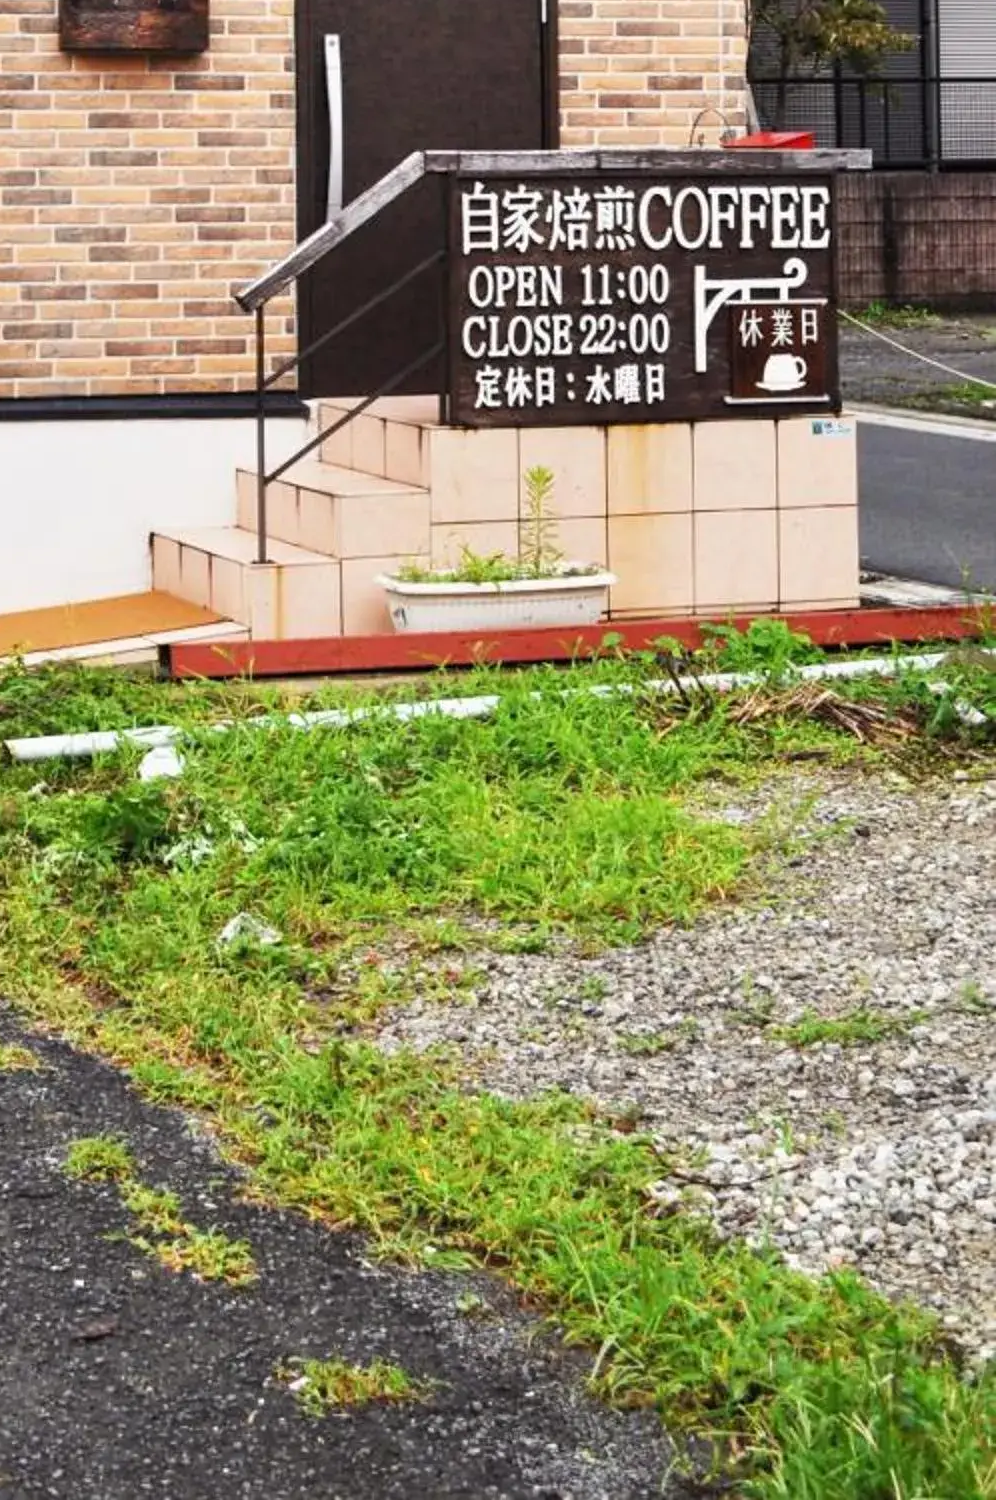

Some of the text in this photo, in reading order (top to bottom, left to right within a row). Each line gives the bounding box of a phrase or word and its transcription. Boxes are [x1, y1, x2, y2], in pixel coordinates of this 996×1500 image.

[468, 264, 670, 308] OPEN 11:00
[462, 313, 671, 358] CLOSE 22:00
[739, 308, 819, 348] 休業日
